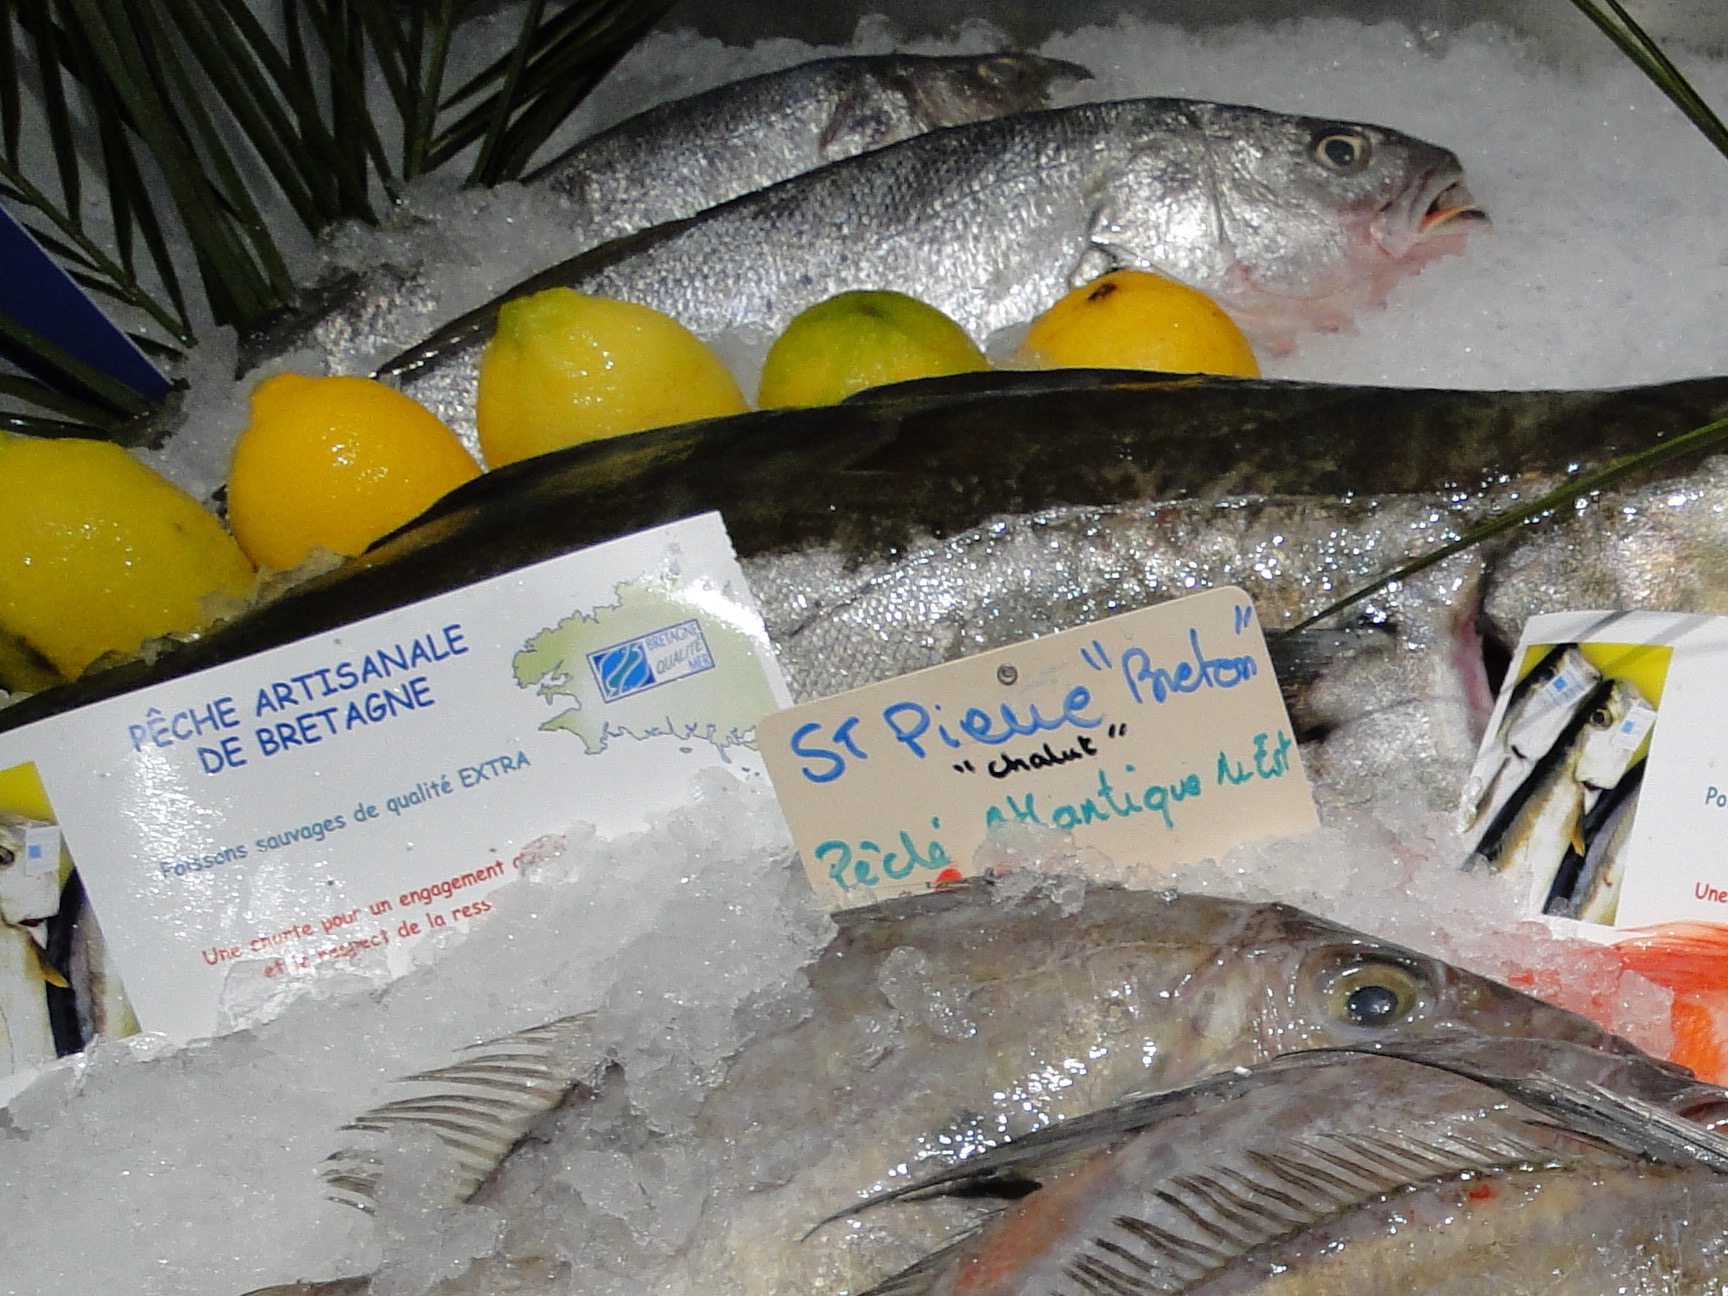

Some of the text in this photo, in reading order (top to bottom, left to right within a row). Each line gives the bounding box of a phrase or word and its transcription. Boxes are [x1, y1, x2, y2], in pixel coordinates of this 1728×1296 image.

[644, 622, 700, 650] BRETAGNE
[656, 635, 704, 675] QUALITÉ
[127, 623, 470, 753] PÊCHE ARTISANALE
[197, 676, 436, 775] DE BRETAGNE
[255, 813, 348, 855] sauvages
[353, 801, 379, 824] de
[387, 773, 454, 816] qualité
[457, 749, 531, 789] EXTRA
[203, 945, 243, 967] Une
[320, 908, 362, 935] pour
[369, 897, 394, 918] un
[399, 859, 505, 909] engagement
[1695, 881, 1728, 904] Une
[263, 960, 286, 979] et
[398, 911, 422, 938] de
[427, 906, 447, 929] la
[451, 900, 492, 922] ress
